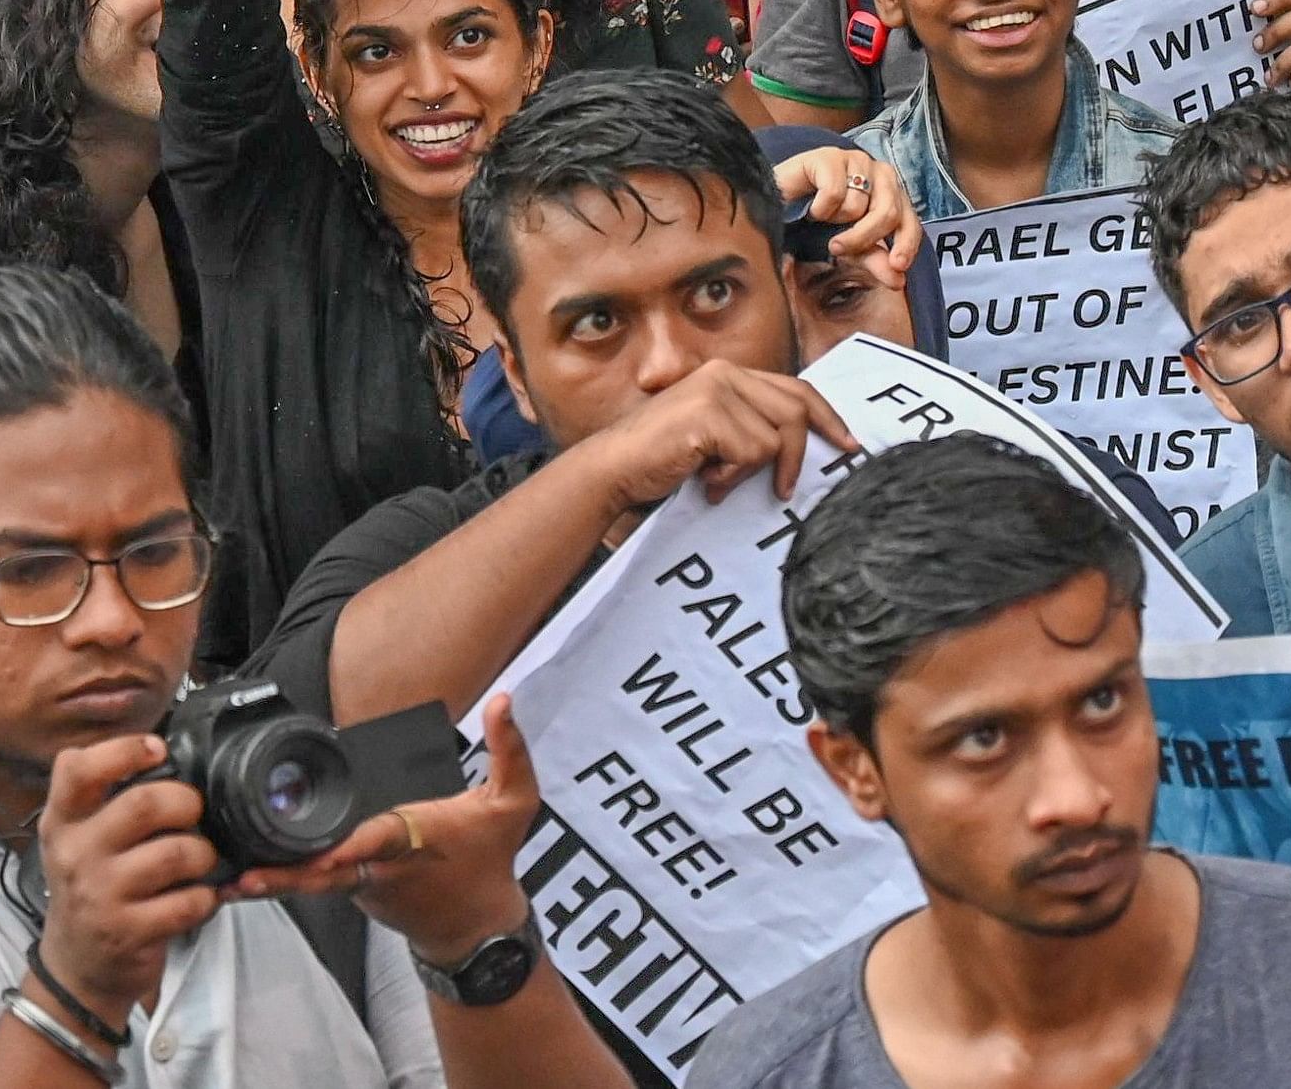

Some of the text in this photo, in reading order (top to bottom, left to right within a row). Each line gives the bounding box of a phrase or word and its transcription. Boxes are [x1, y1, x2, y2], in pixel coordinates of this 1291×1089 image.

[947, 285, 1148, 339] OUT OF
[621, 652, 840, 868] WILL BE
[1158, 735, 1271, 790] FREE
[573, 751, 738, 901] FREE!
